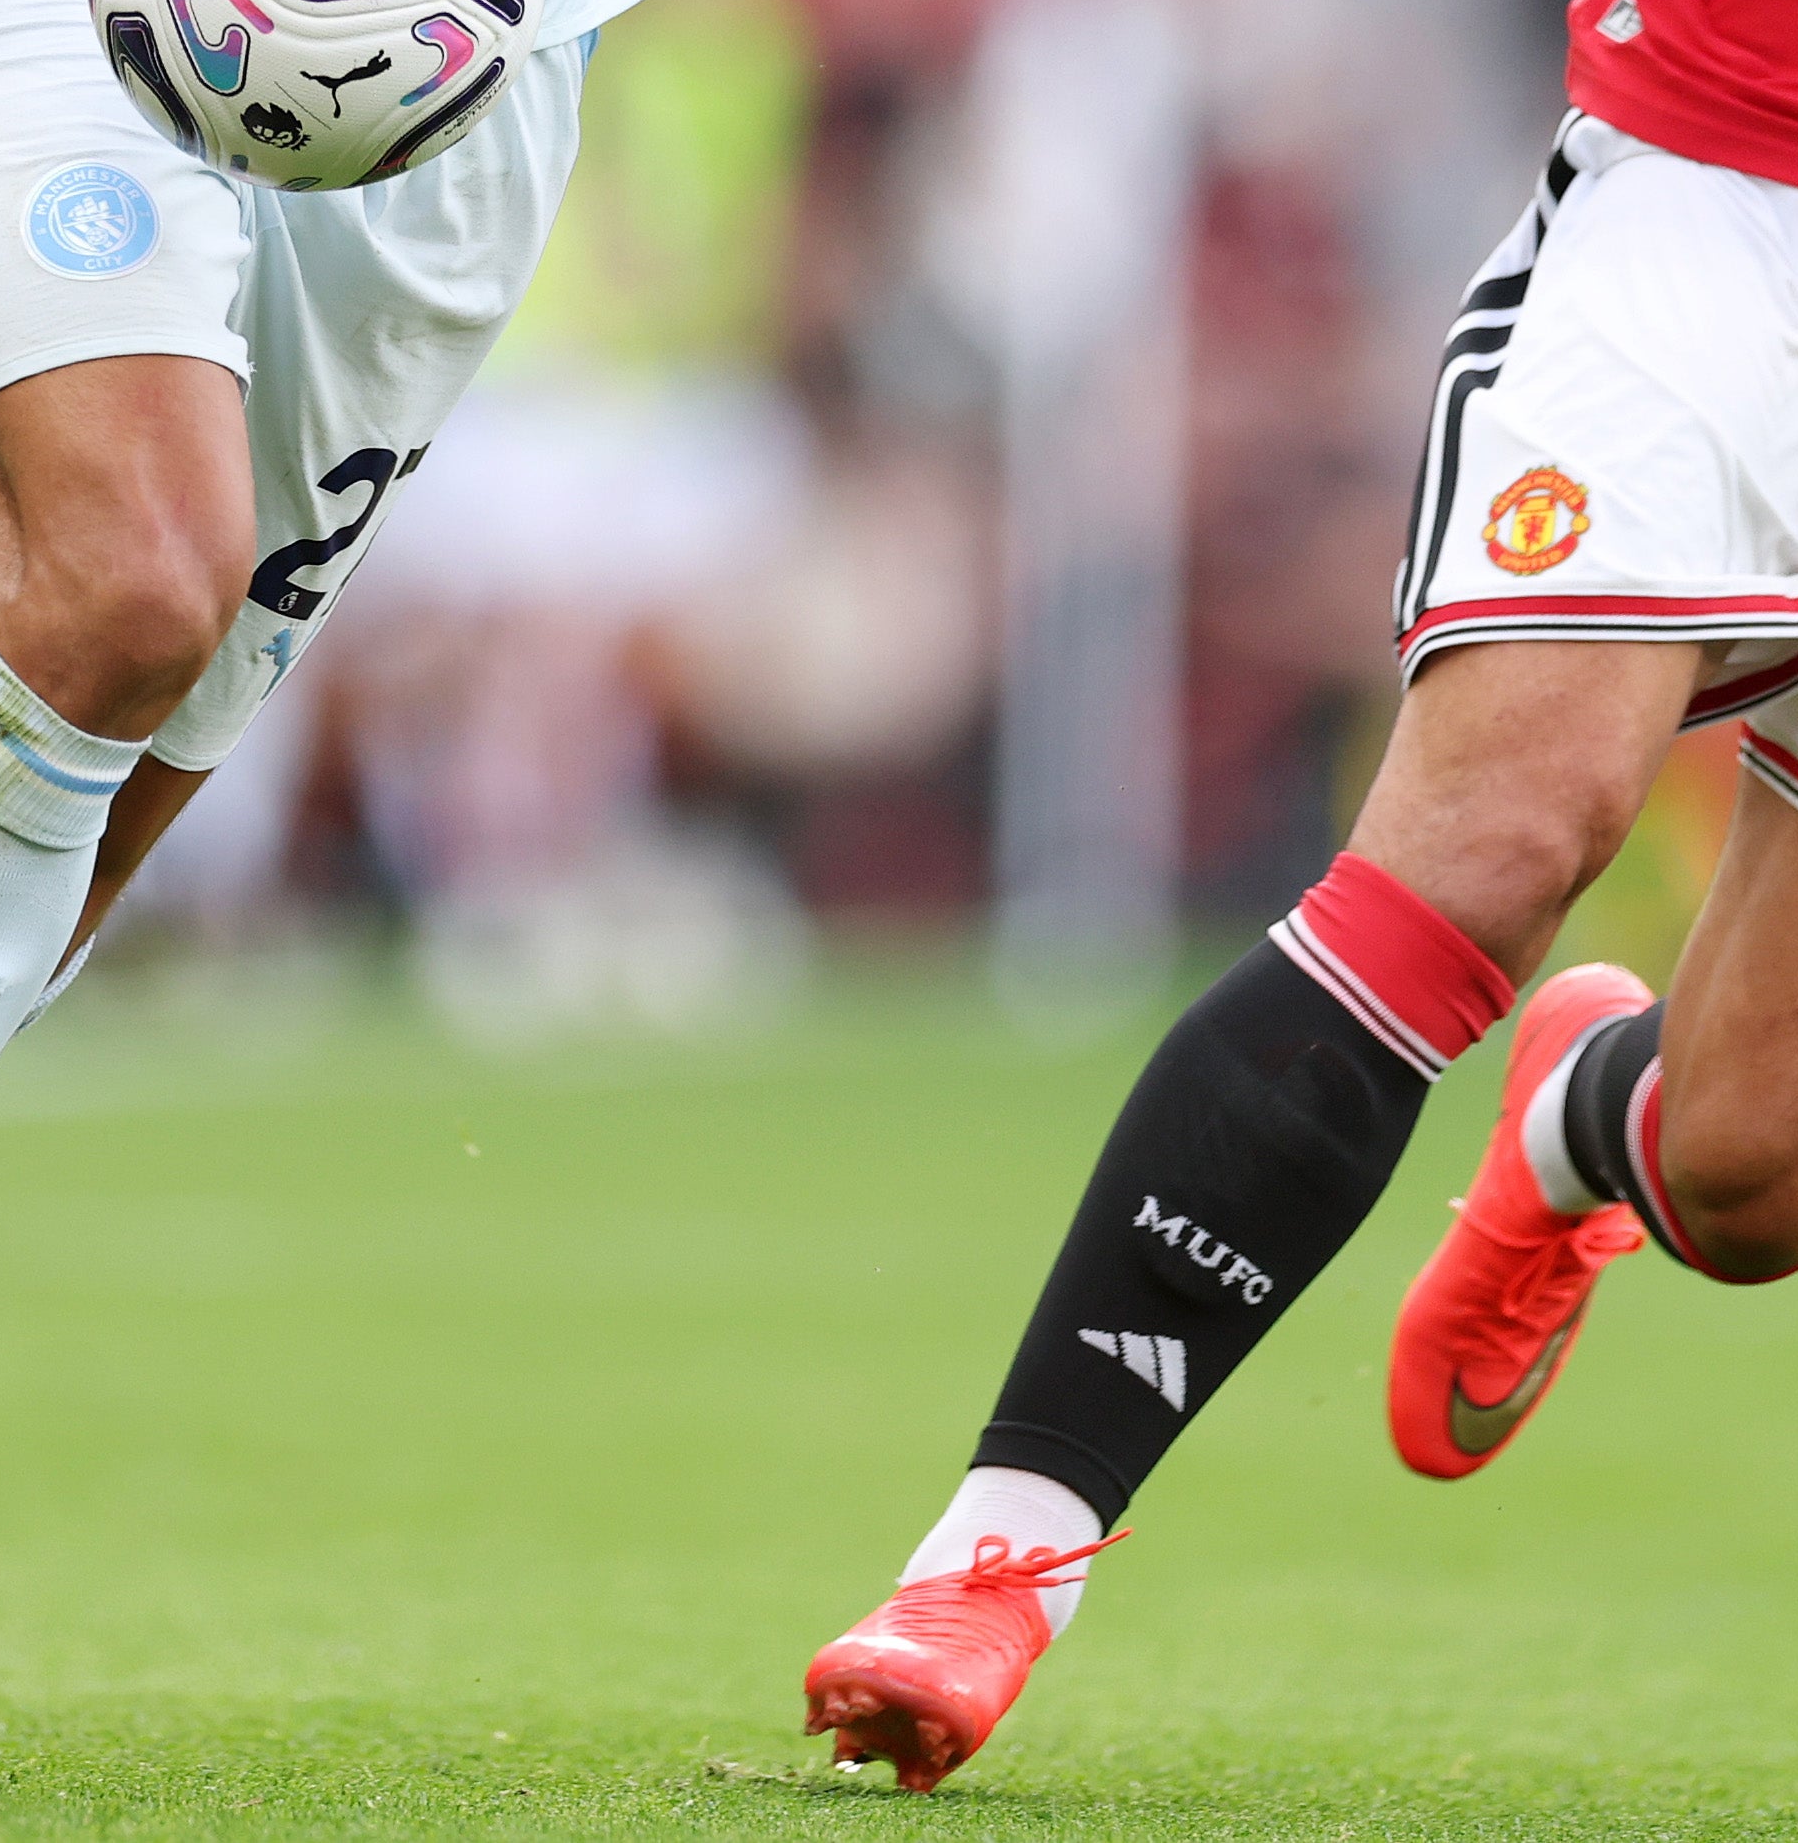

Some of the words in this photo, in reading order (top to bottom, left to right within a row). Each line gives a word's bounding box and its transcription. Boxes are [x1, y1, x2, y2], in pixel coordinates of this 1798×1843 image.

[33, 168, 141, 215] MANCHESTER
[83, 255, 123, 270] CITY
[247, 440, 432, 621] 2
[1131, 1194, 1274, 1305] MUFC
